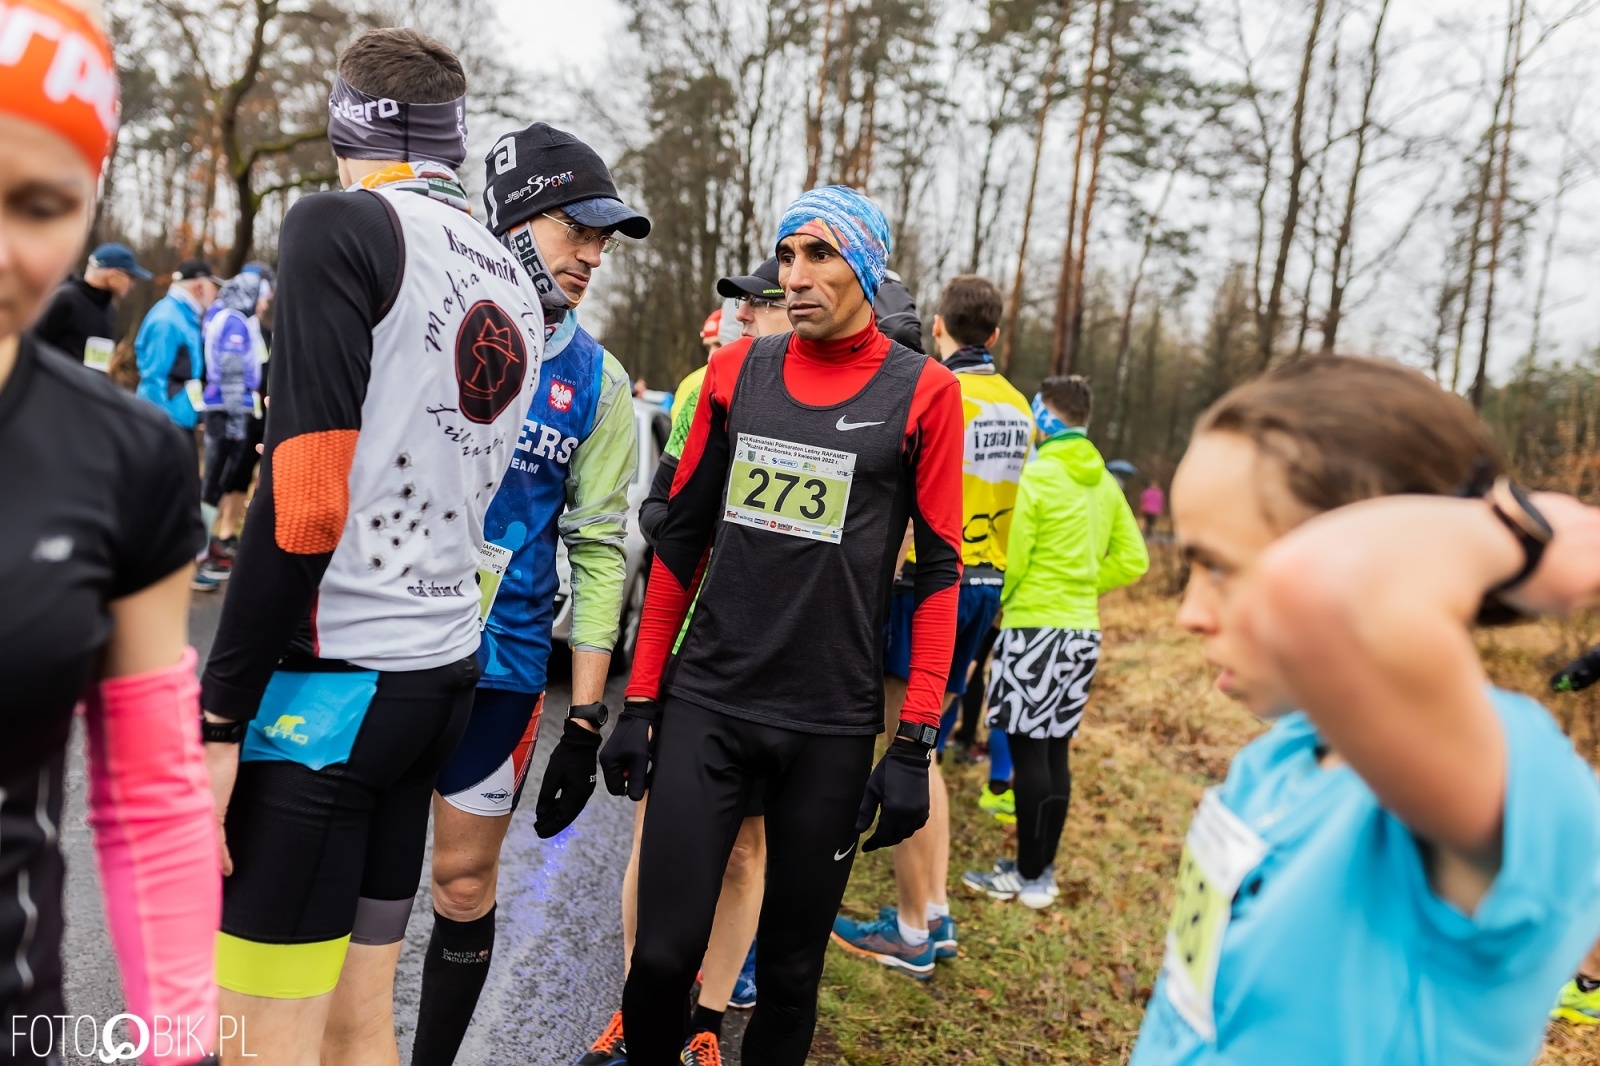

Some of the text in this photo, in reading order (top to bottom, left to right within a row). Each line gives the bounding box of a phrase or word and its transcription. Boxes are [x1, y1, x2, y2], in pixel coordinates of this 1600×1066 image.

[442, 224, 519, 287] Kierownik
[514, 229, 553, 295] BIEG
[551, 373, 577, 387] POLAND
[975, 431, 979, 449] i
[764, 445, 793, 457] Raciborska,
[798, 452, 821, 462] kwiecień
[821, 456, 835, 465] 2022
[775, 441, 804, 452] Półmaraton
[804, 446, 821, 456] Leśny
[821, 450, 849, 460] RAFAMET
[743, 467, 828, 520] 273
[480, 548, 493, 557] 2022
[443, 948, 476, 958] DANISH
